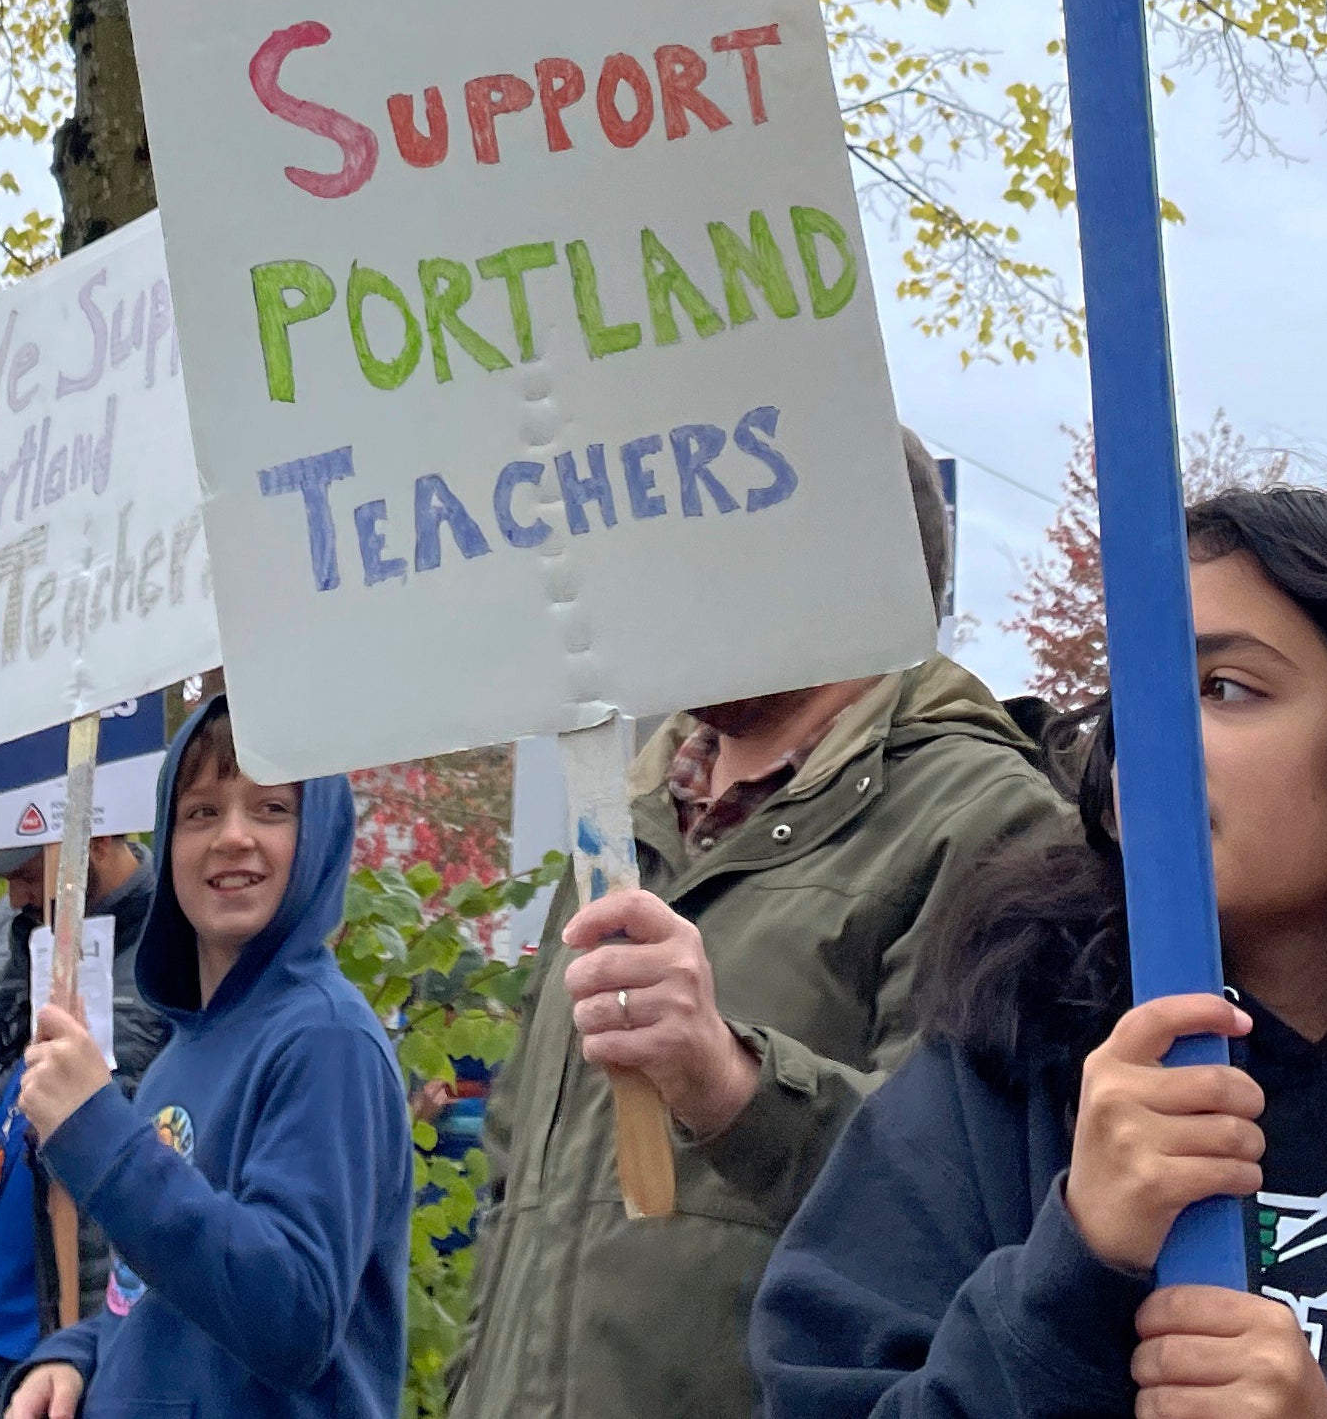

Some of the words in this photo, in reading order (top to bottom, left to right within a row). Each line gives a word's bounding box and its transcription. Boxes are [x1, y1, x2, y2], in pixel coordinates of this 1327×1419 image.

[248, 19, 781, 200] SUPPORT
[55, 267, 181, 401] Sup
[249, 204, 858, 405] PORTLAND
[257, 404, 800, 592] TEACHERS
